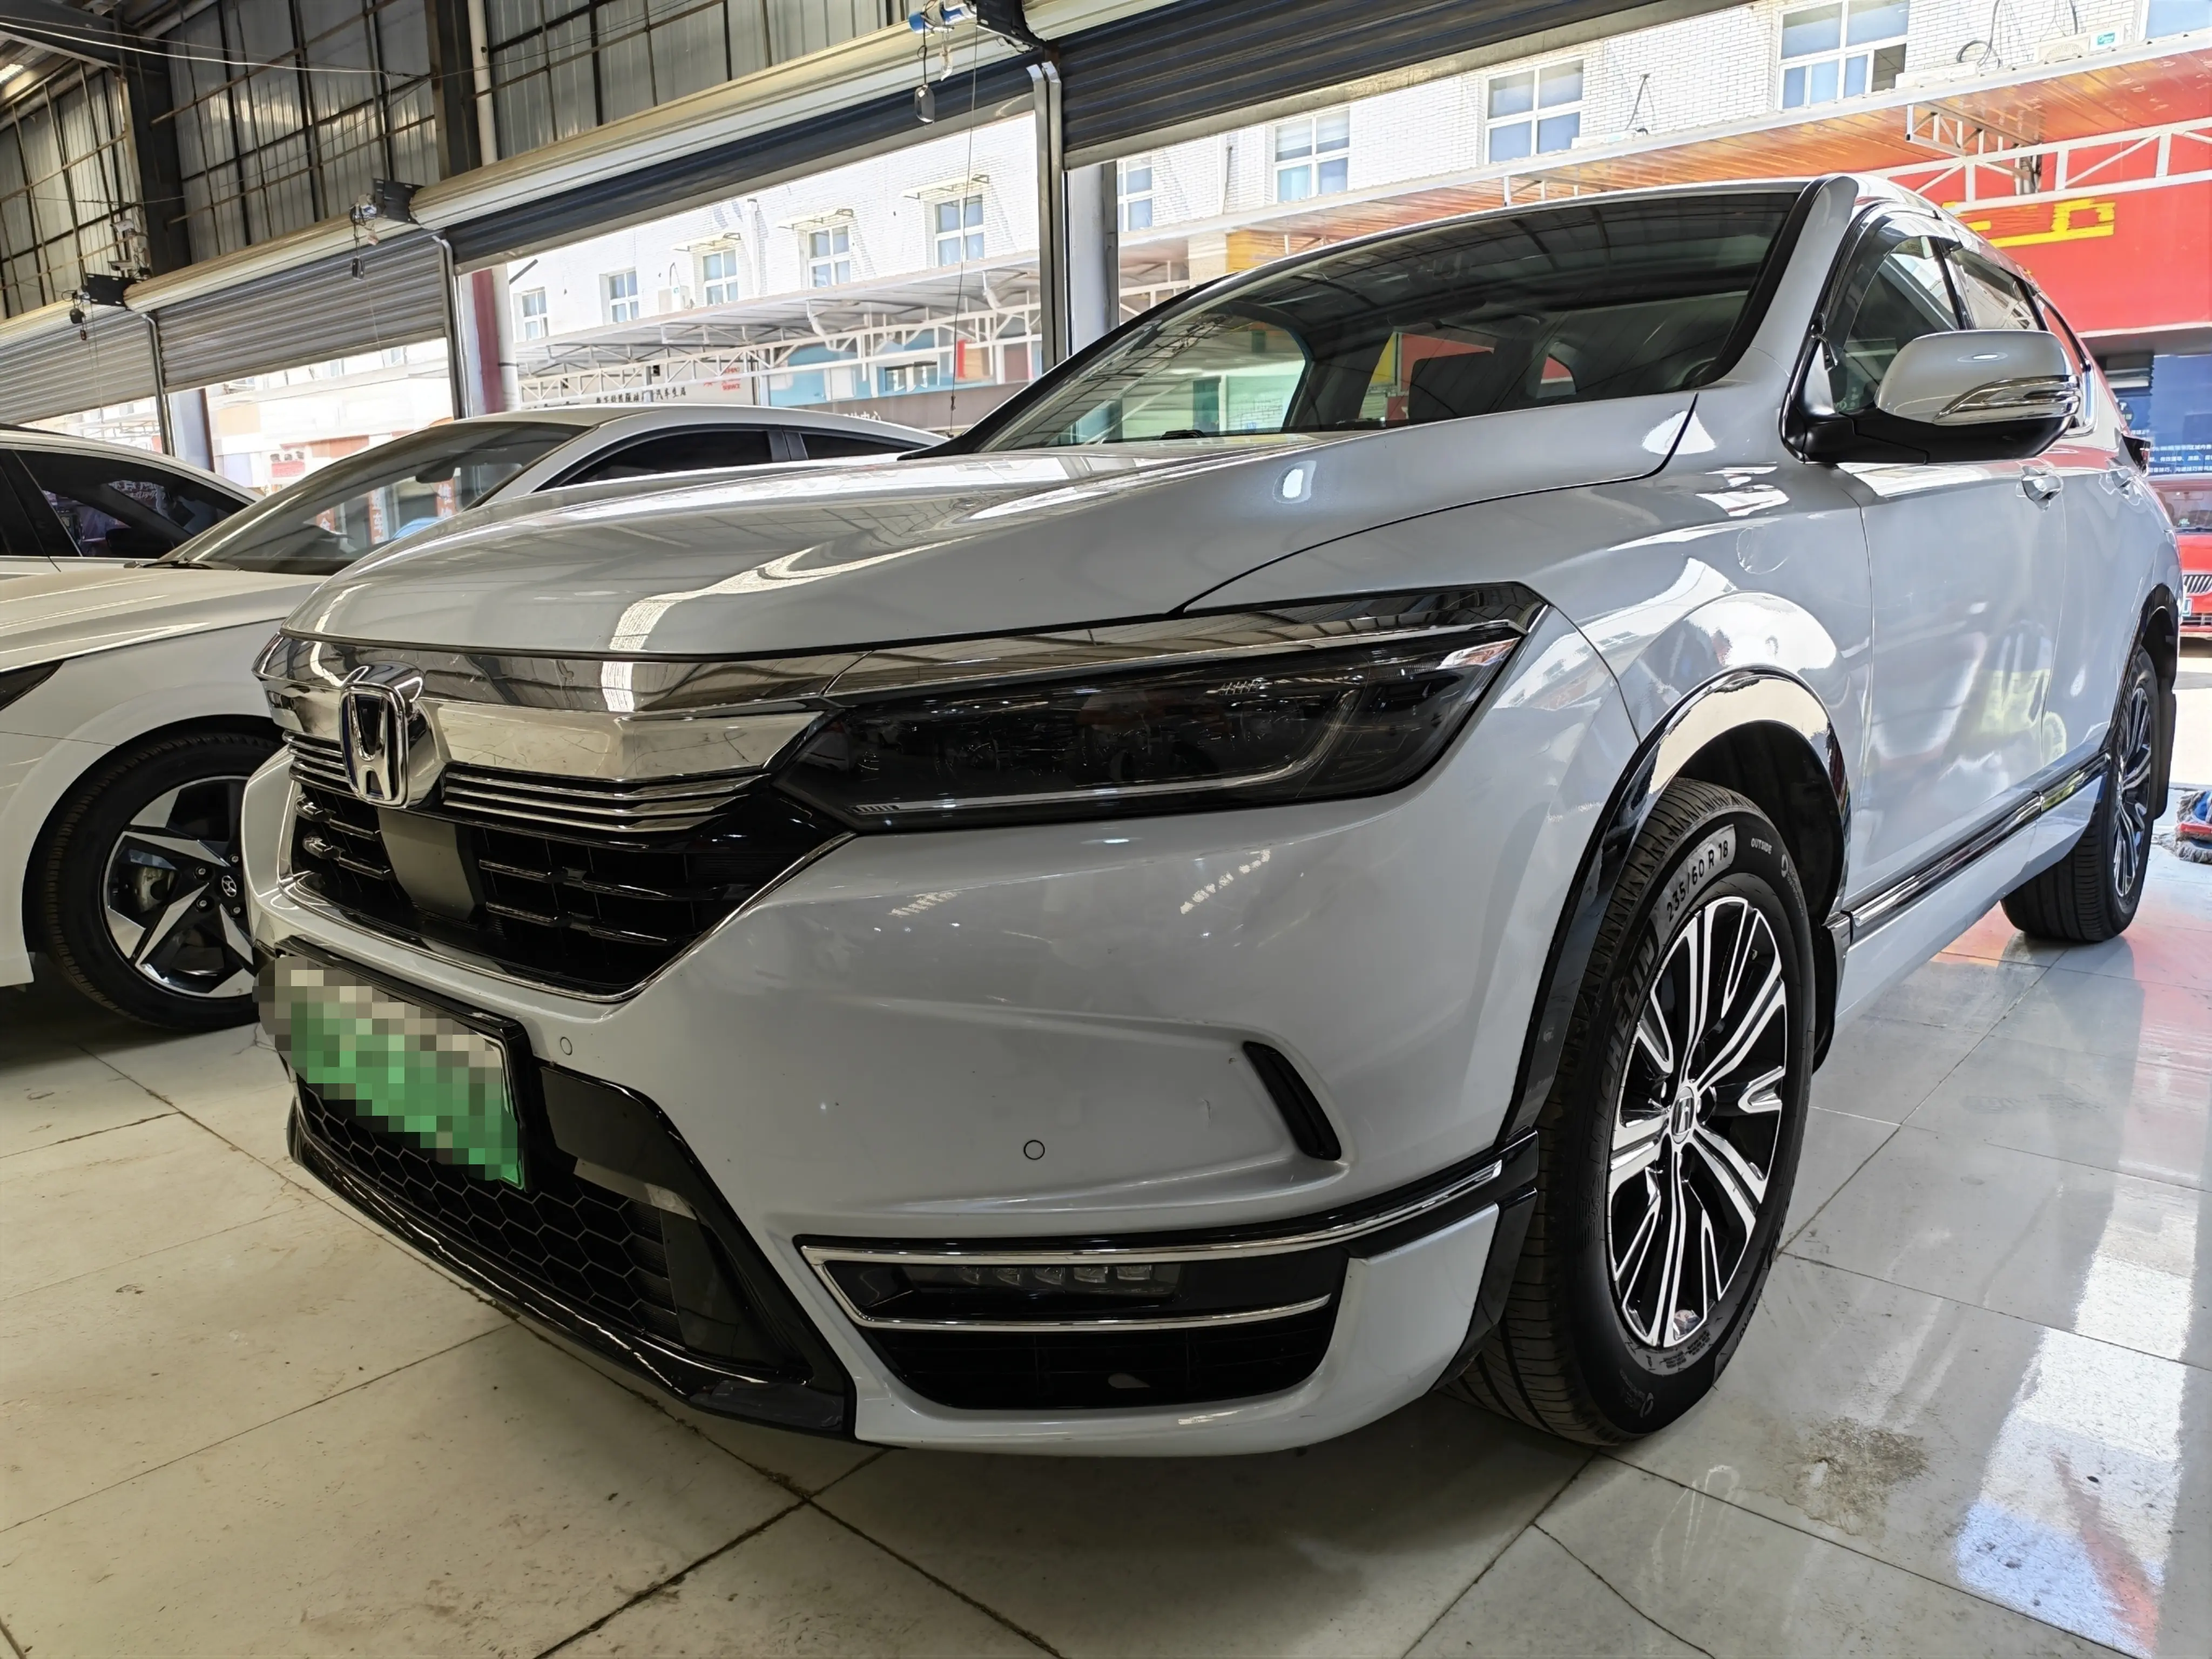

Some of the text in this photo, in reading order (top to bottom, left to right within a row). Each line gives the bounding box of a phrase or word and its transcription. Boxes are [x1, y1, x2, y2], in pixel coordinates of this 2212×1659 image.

[1751, 838, 1772, 855] OUTSIDE
[1667, 840, 1728, 922] 235/60 R 18
